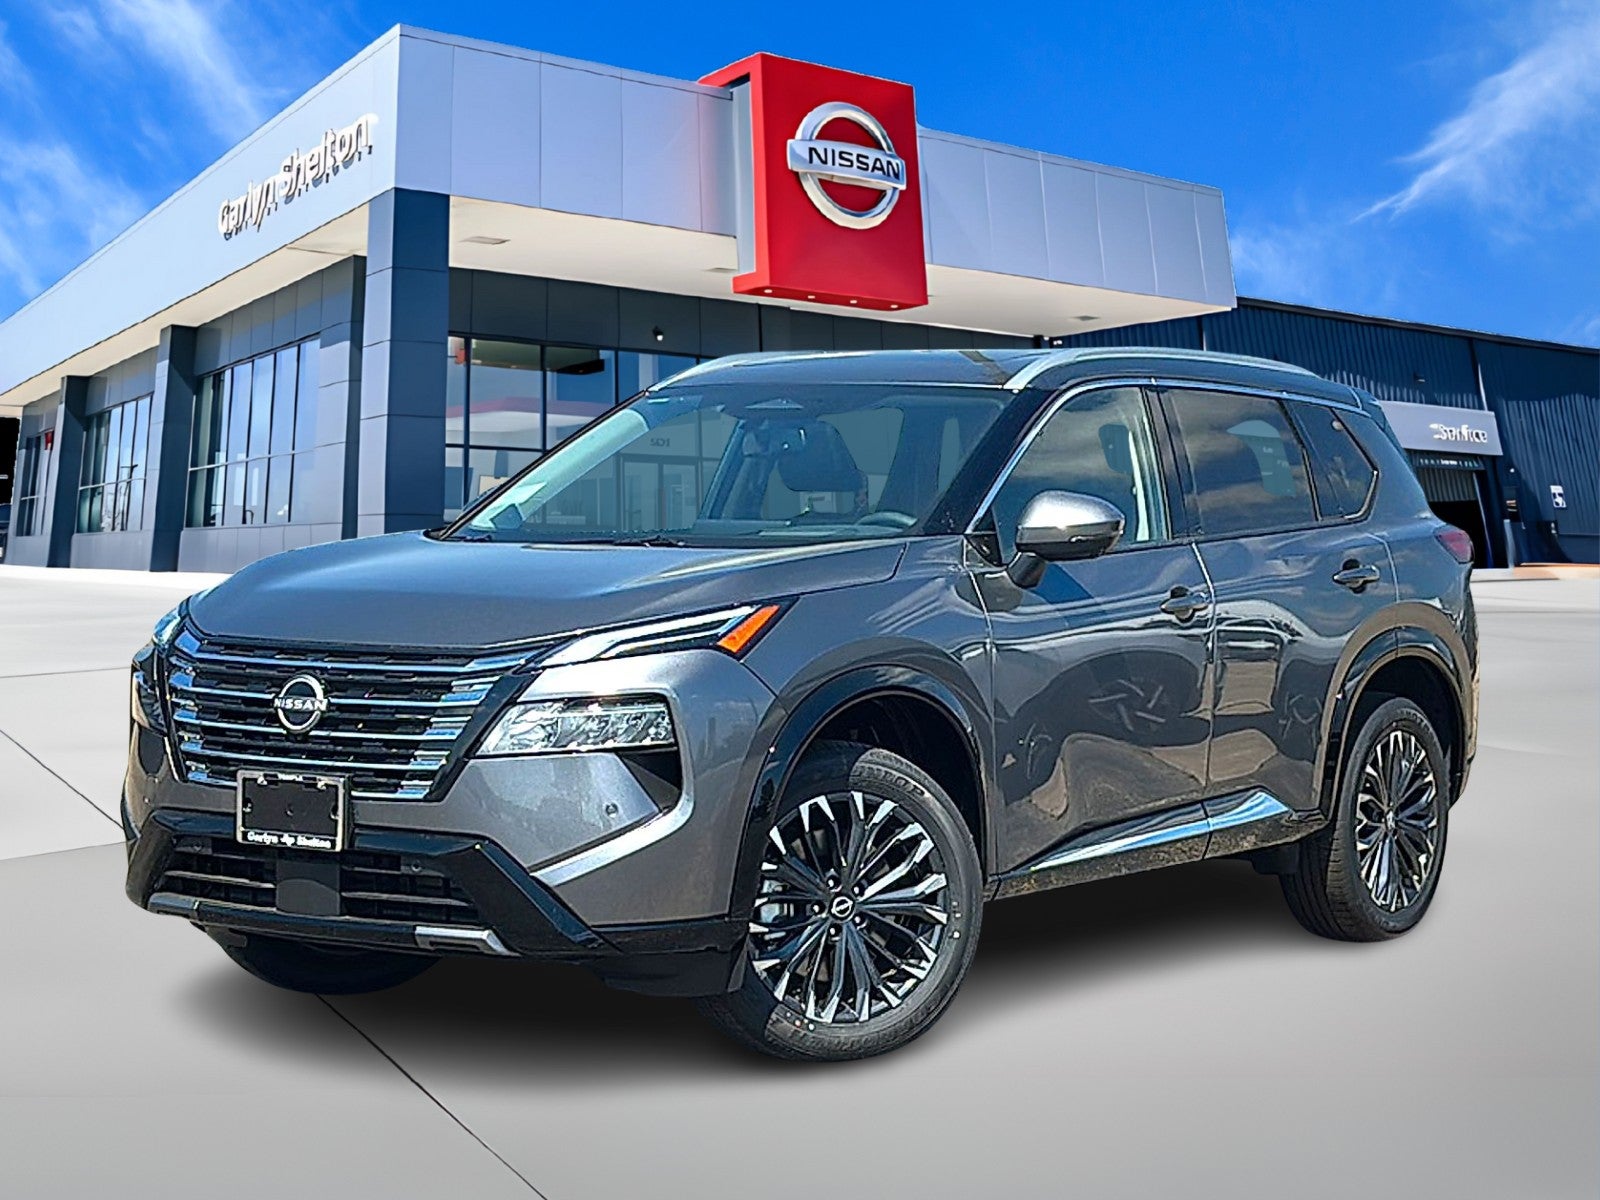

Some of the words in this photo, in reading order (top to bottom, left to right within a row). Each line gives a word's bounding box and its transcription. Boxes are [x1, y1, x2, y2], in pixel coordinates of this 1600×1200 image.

[281, 116, 373, 203] Shelton
[808, 146, 900, 180] NISSAN
[274, 698, 328, 711] NISSAN
